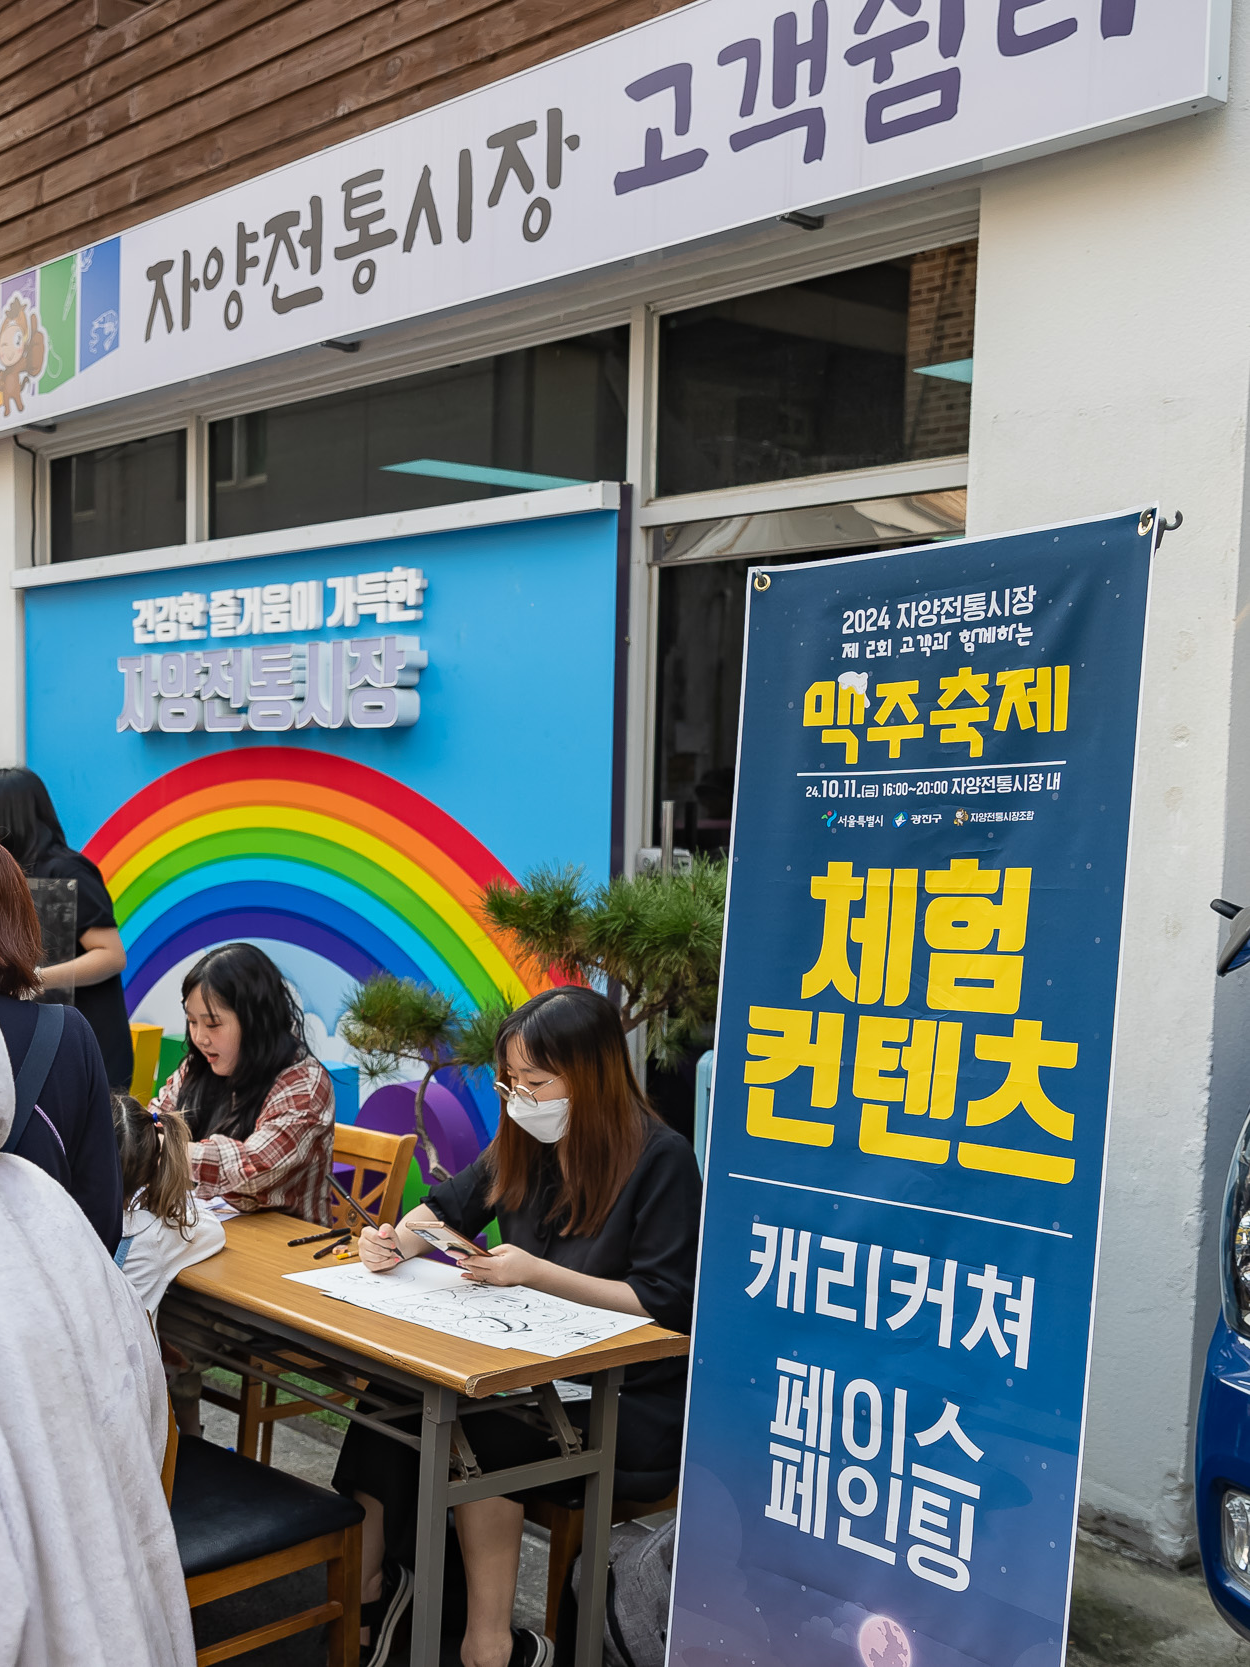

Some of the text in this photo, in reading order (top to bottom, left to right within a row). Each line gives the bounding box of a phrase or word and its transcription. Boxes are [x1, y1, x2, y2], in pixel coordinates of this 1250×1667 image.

[145, 107, 580, 342] 자양전통시장
[132, 566, 429, 645] 건강한 즐거움이 가득한
[841, 641, 860, 659] 제
[899, 631, 952, 657] 고객과
[958, 622, 1034, 653] 함께하는
[842, 585, 1037, 634] 2024 자양전통시장
[116, 634, 429, 734] 자양전통시장
[837, 814, 884, 828] 서울특별시
[882, 780, 948, 797] 16:00~20:00
[951, 773, 1043, 795] 자양전통시장
[1046, 772, 1062, 791] 내
[910, 814, 943, 825] 광진구
[969, 810, 1036, 823] 자양전통시장조합
[800, 858, 1033, 1015] 체험
[743, 1005, 1080, 1185] 컨텐츠
[744, 1222, 1036, 1371] 캐리커쳐
[768, 1357, 986, 1500] 페이스
[764, 1441, 976, 1593] 페인팅
